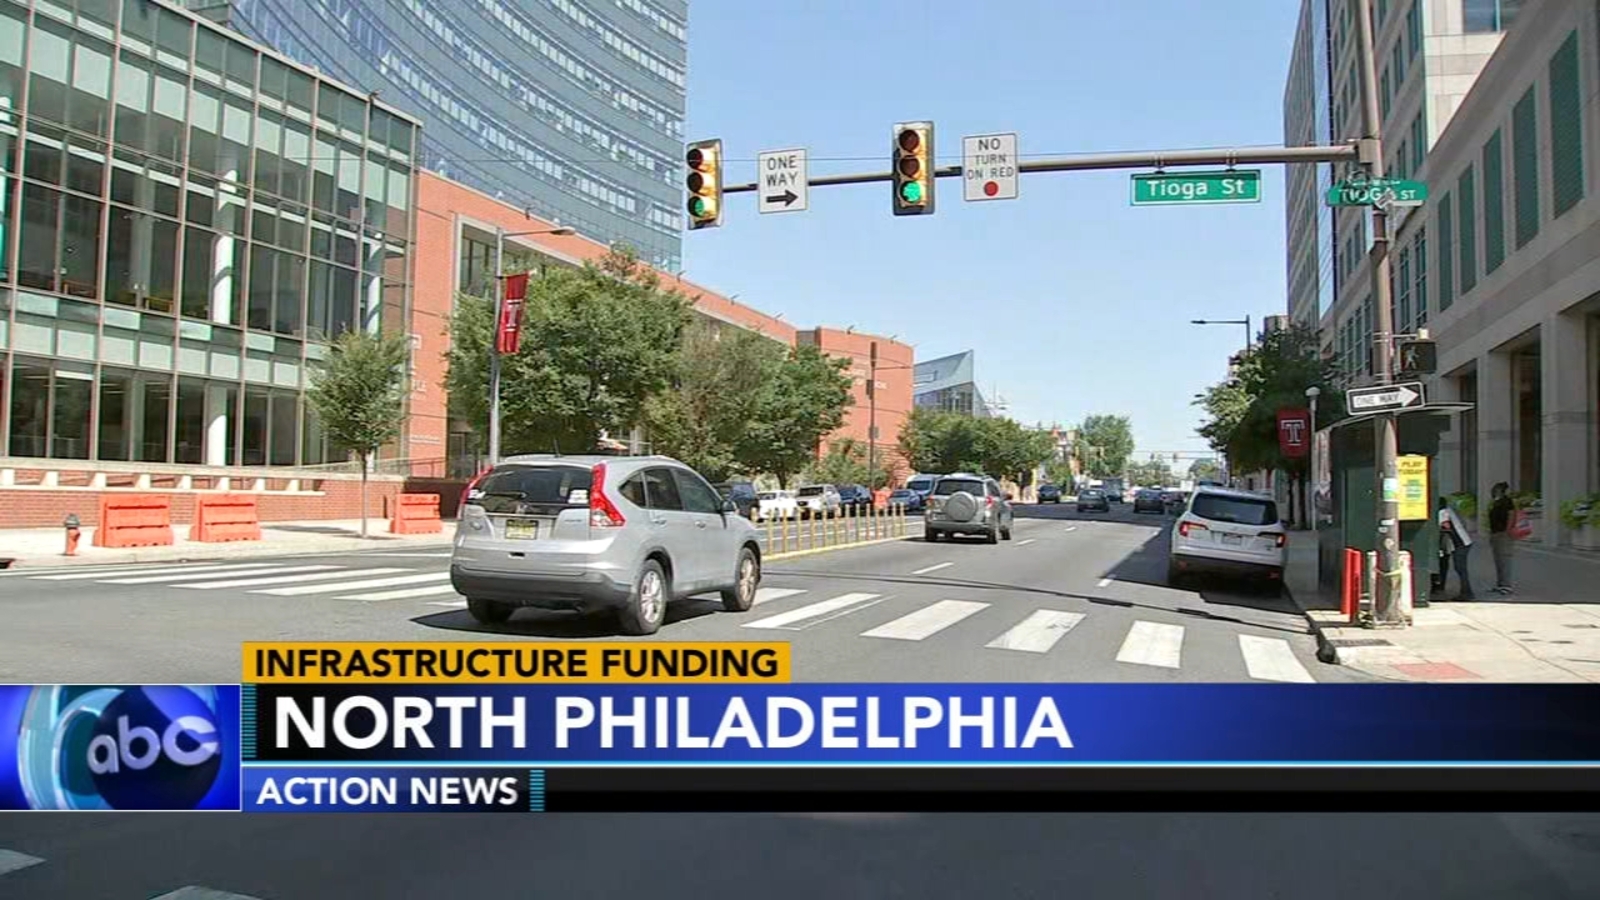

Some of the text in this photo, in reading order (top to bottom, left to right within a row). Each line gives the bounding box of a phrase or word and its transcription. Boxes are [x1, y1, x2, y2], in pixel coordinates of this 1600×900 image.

[977, 138, 1001, 151] NO
[766, 156, 797, 171] ONE
[975, 154, 1007, 166] TURN
[765, 172, 799, 188] WAY
[966, 166, 1015, 180] ON RED
[1146, 178, 1244, 201] Tioga St
[1400, 189, 1416, 200] ST
[1355, 392, 1401, 406] ONE WAY
